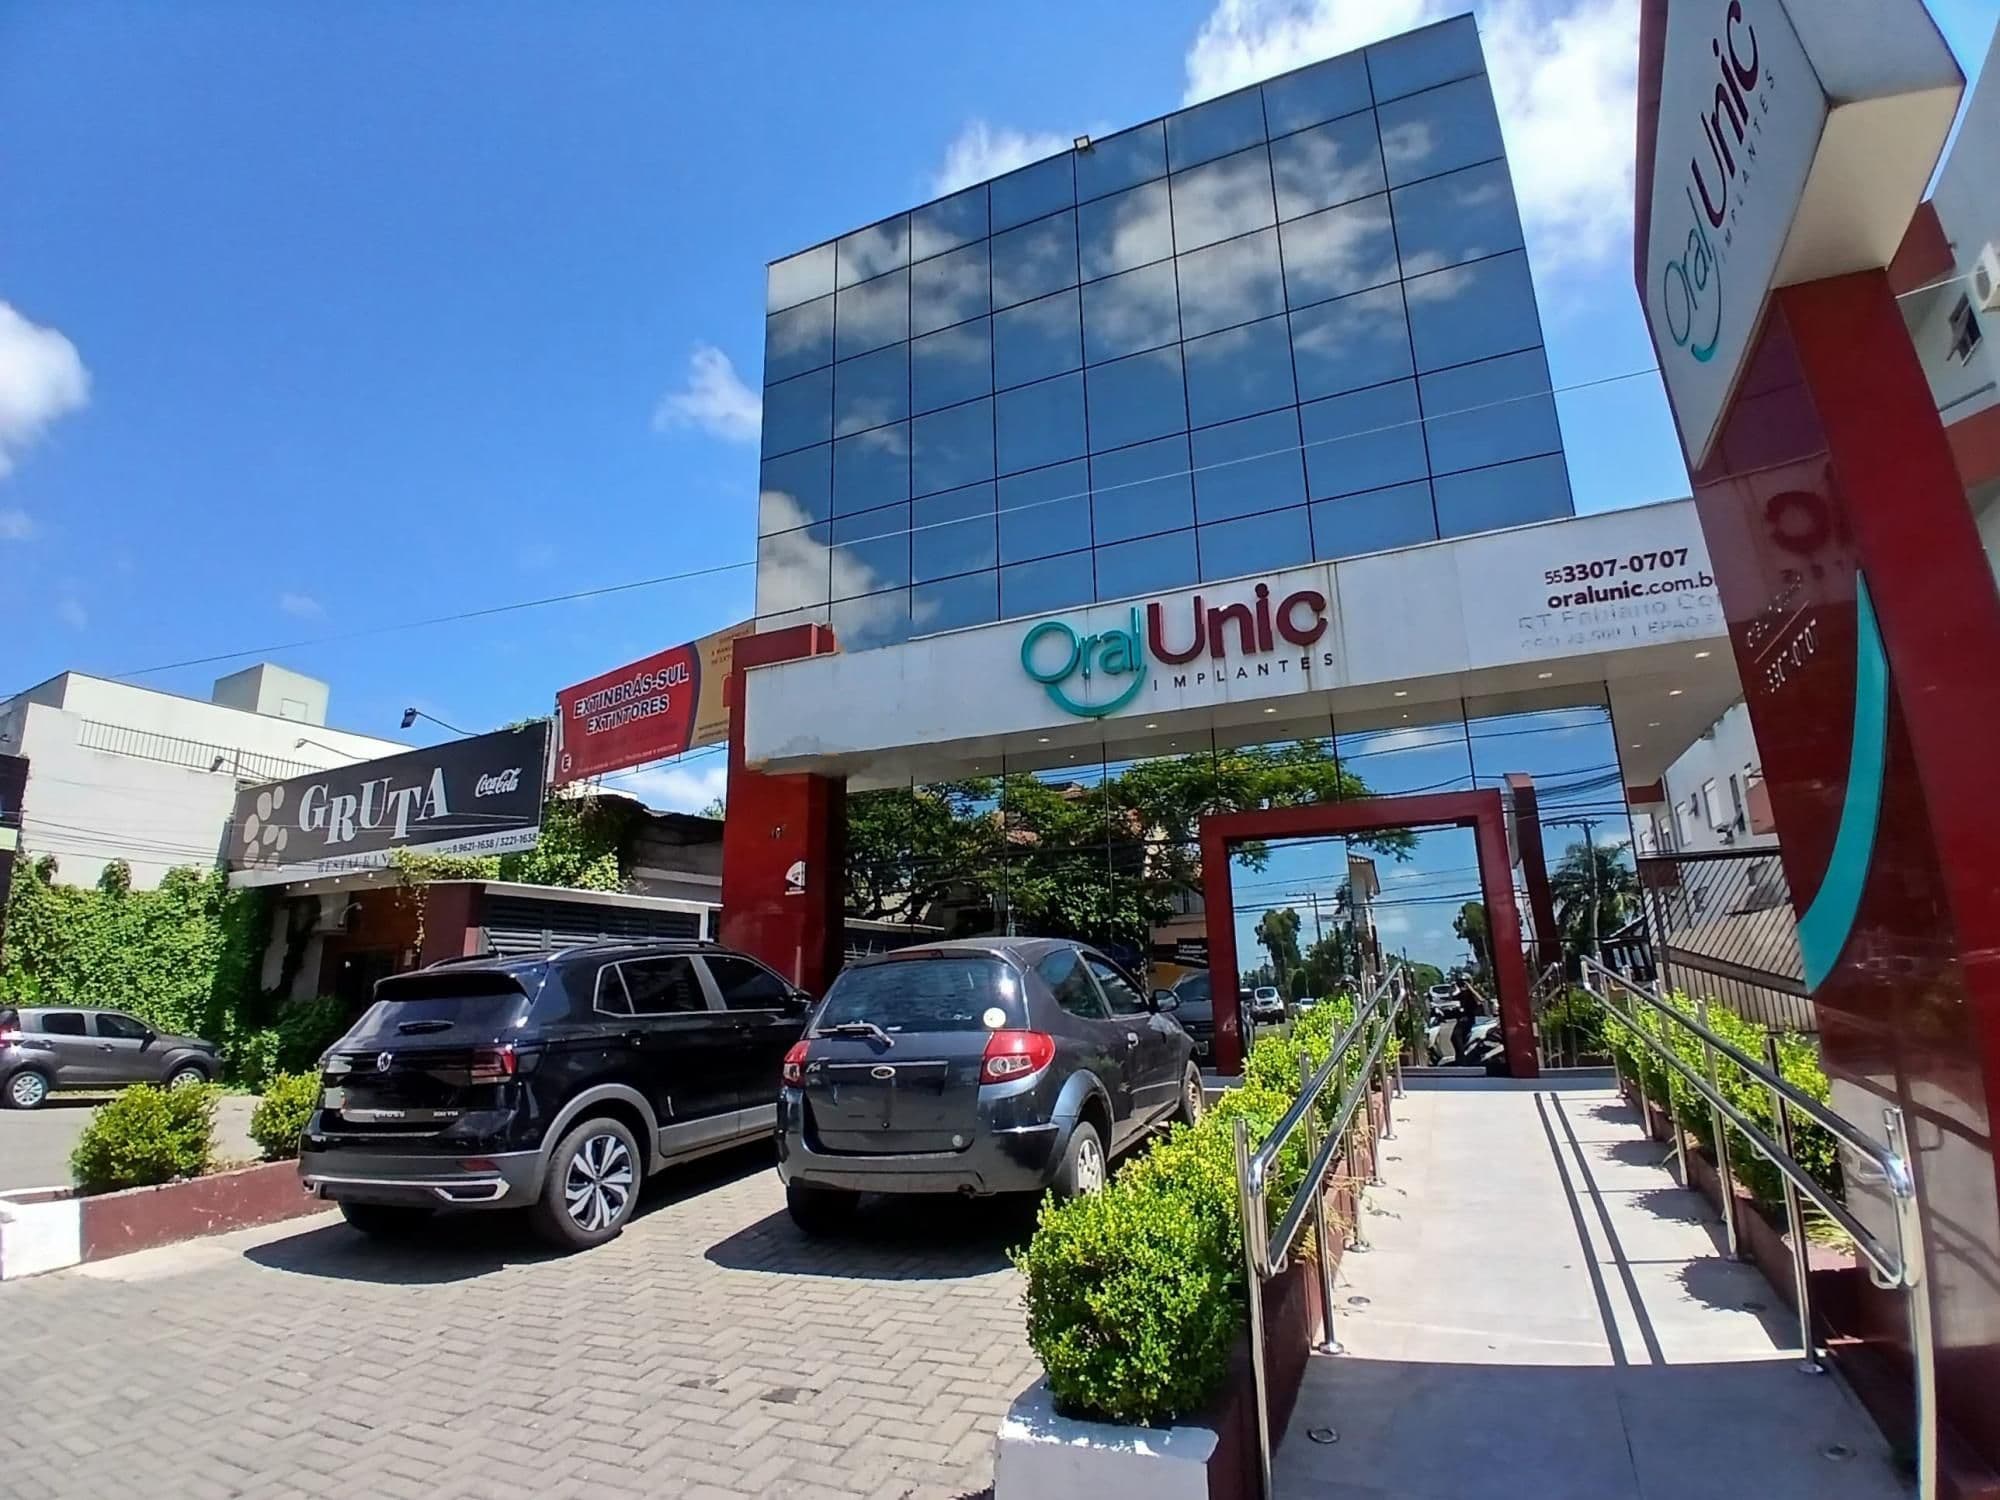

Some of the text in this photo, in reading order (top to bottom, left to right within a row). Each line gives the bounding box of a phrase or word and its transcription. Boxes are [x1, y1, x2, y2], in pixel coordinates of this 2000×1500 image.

[1153, 653, 1334, 691] IMPLANTES
[586, 694, 670, 736] EXTINTORES
[298, 767, 450, 846] GRUTA
